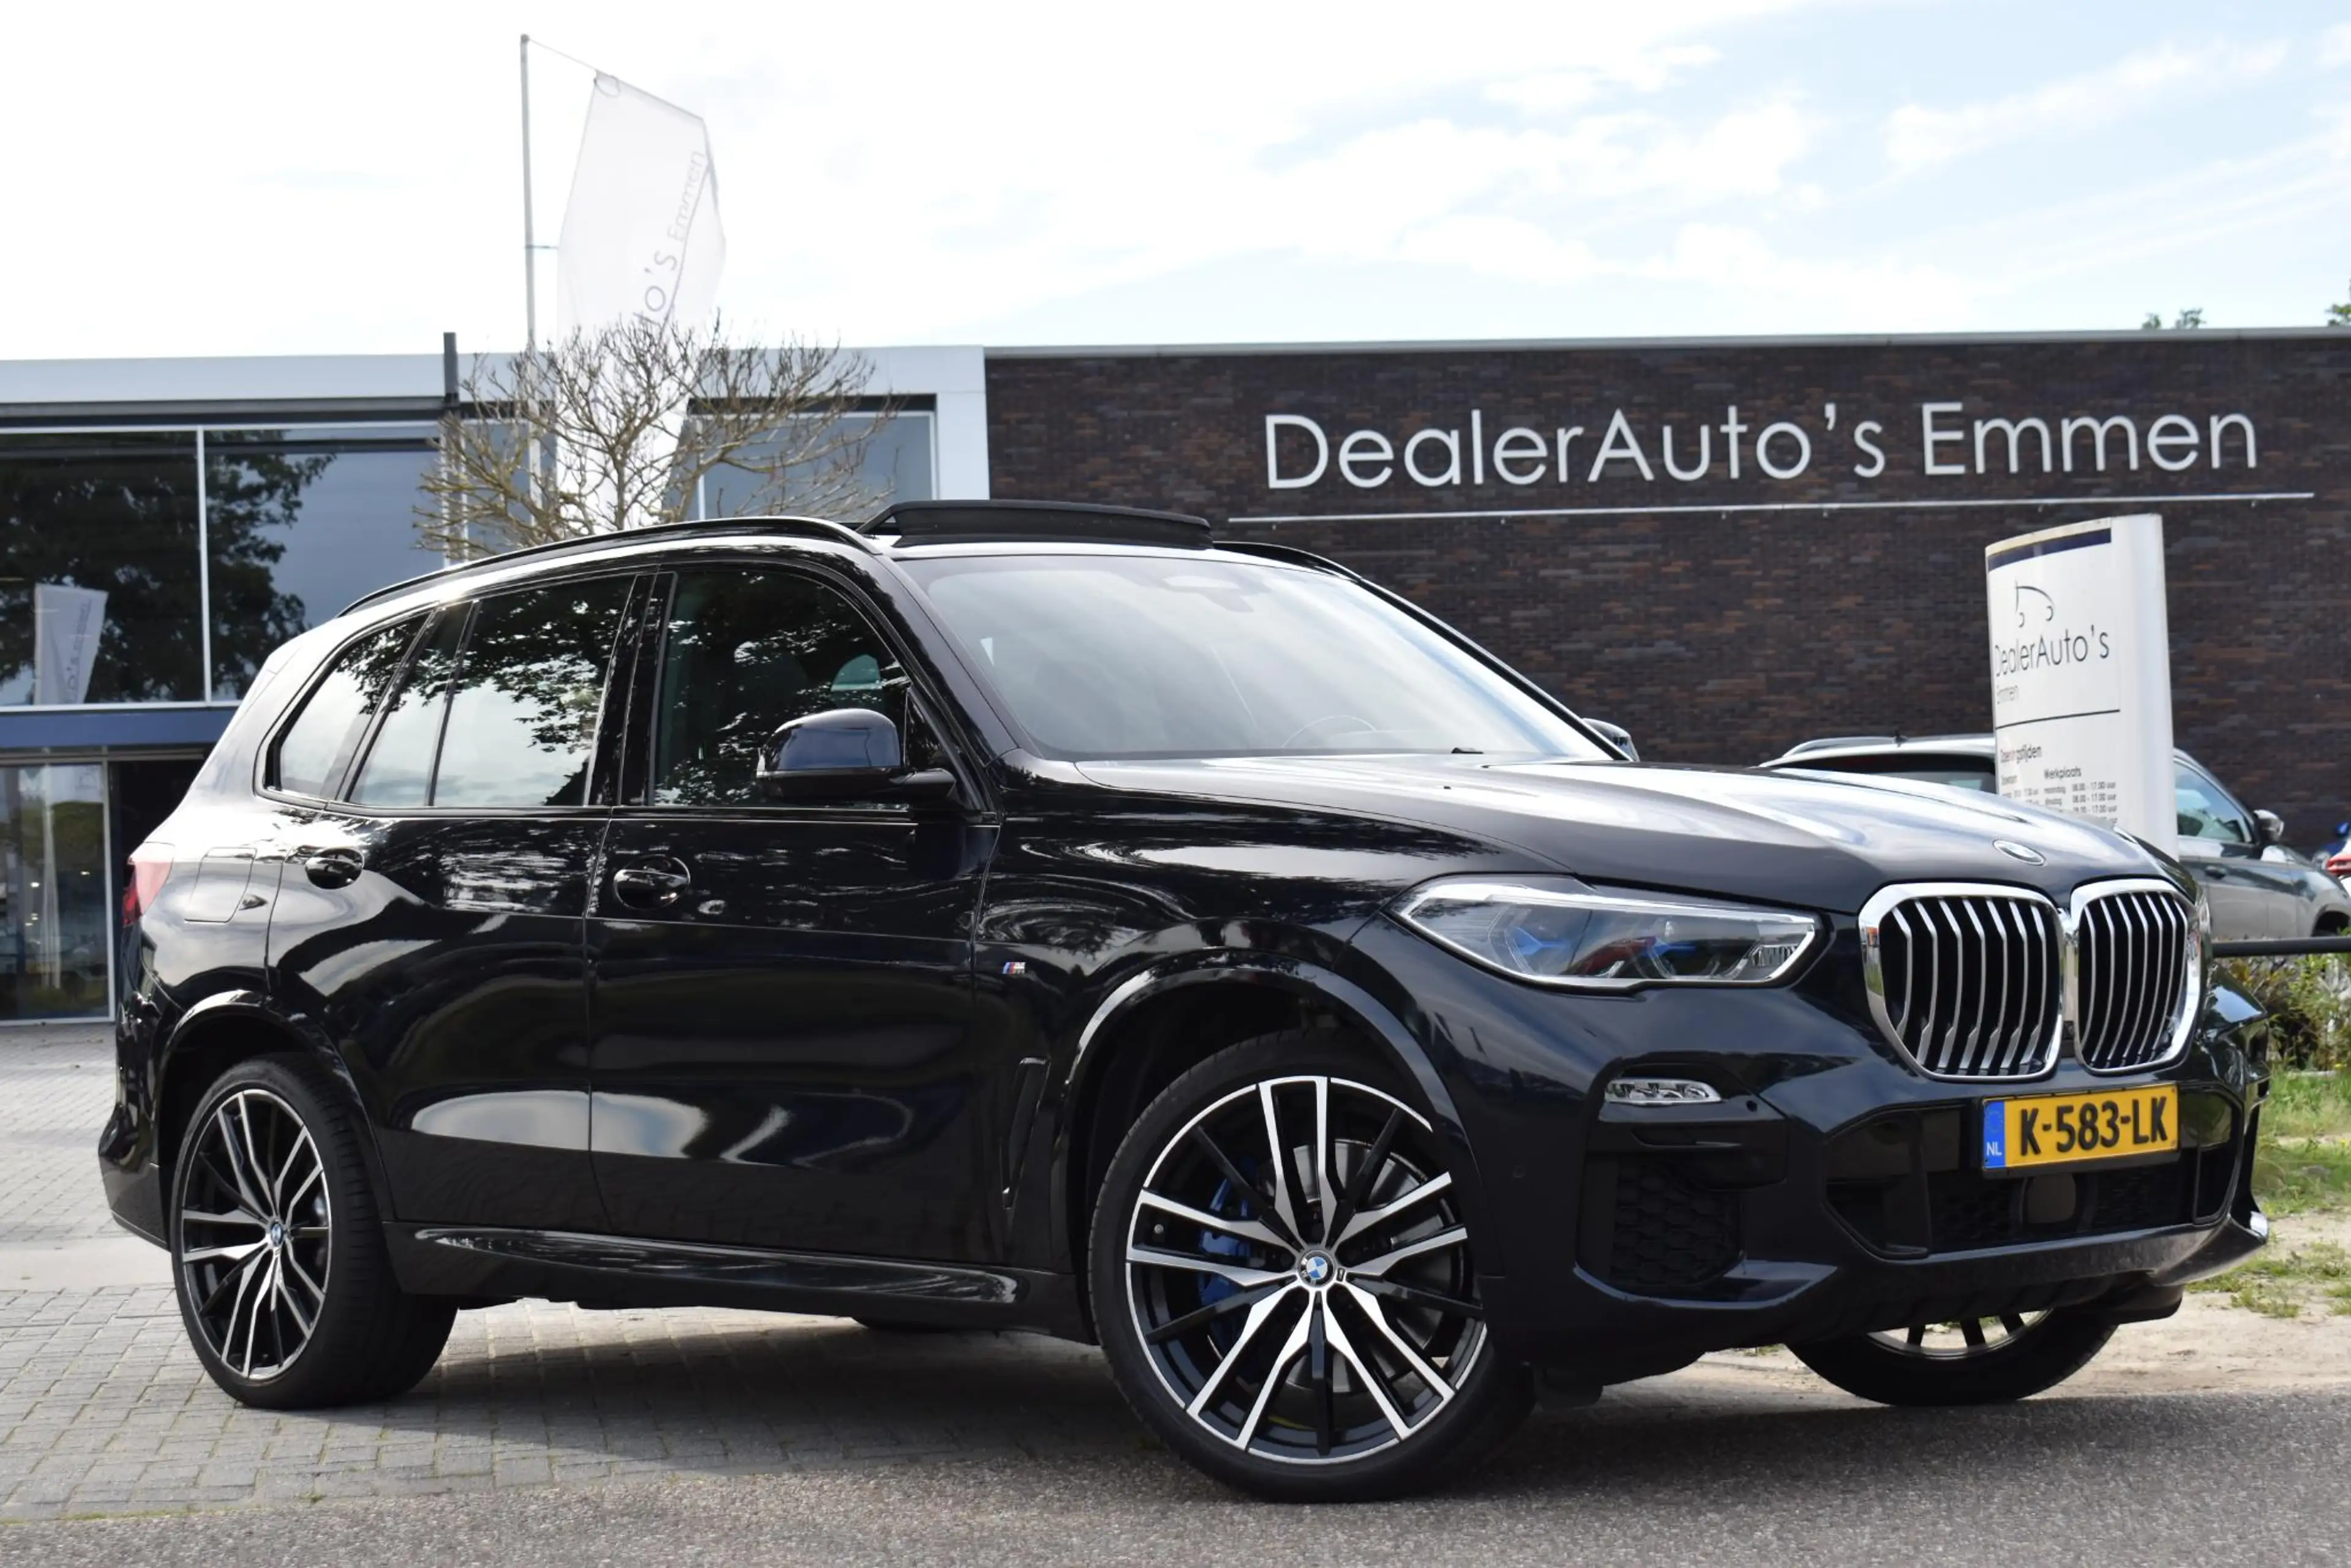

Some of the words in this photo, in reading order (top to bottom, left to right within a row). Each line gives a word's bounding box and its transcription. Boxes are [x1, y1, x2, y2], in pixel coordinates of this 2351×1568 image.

[1265, 402, 1886, 489] DealerAuto's
[1921, 402, 2257, 475] Emmen
[1994, 625, 2110, 677] DealerAuto's
[1986, 1142, 2002, 1156] NL
[2020, 1096, 2168, 1157] K-583-LK
